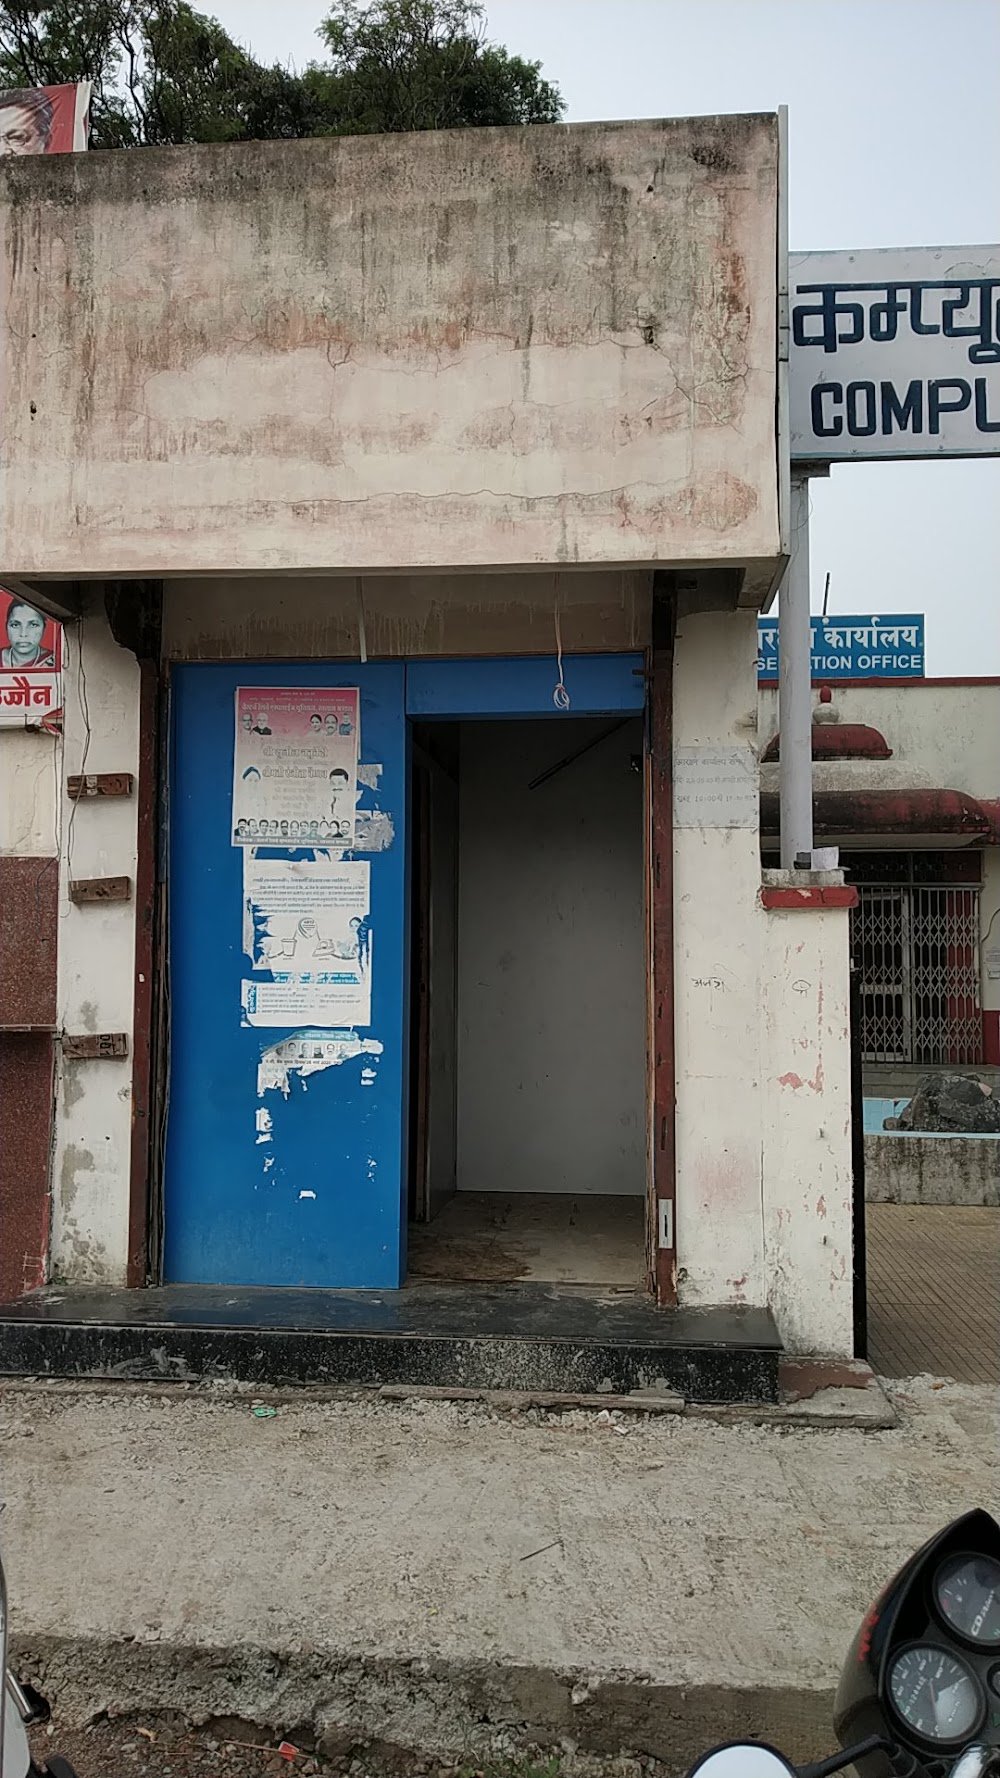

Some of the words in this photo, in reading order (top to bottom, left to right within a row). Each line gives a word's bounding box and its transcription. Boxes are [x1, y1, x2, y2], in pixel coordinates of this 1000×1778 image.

[793, 278, 1000, 365] कम्प्यू
[857, 655, 921, 670] OFFICE
[0, 676, 52, 707] ज्जैन
